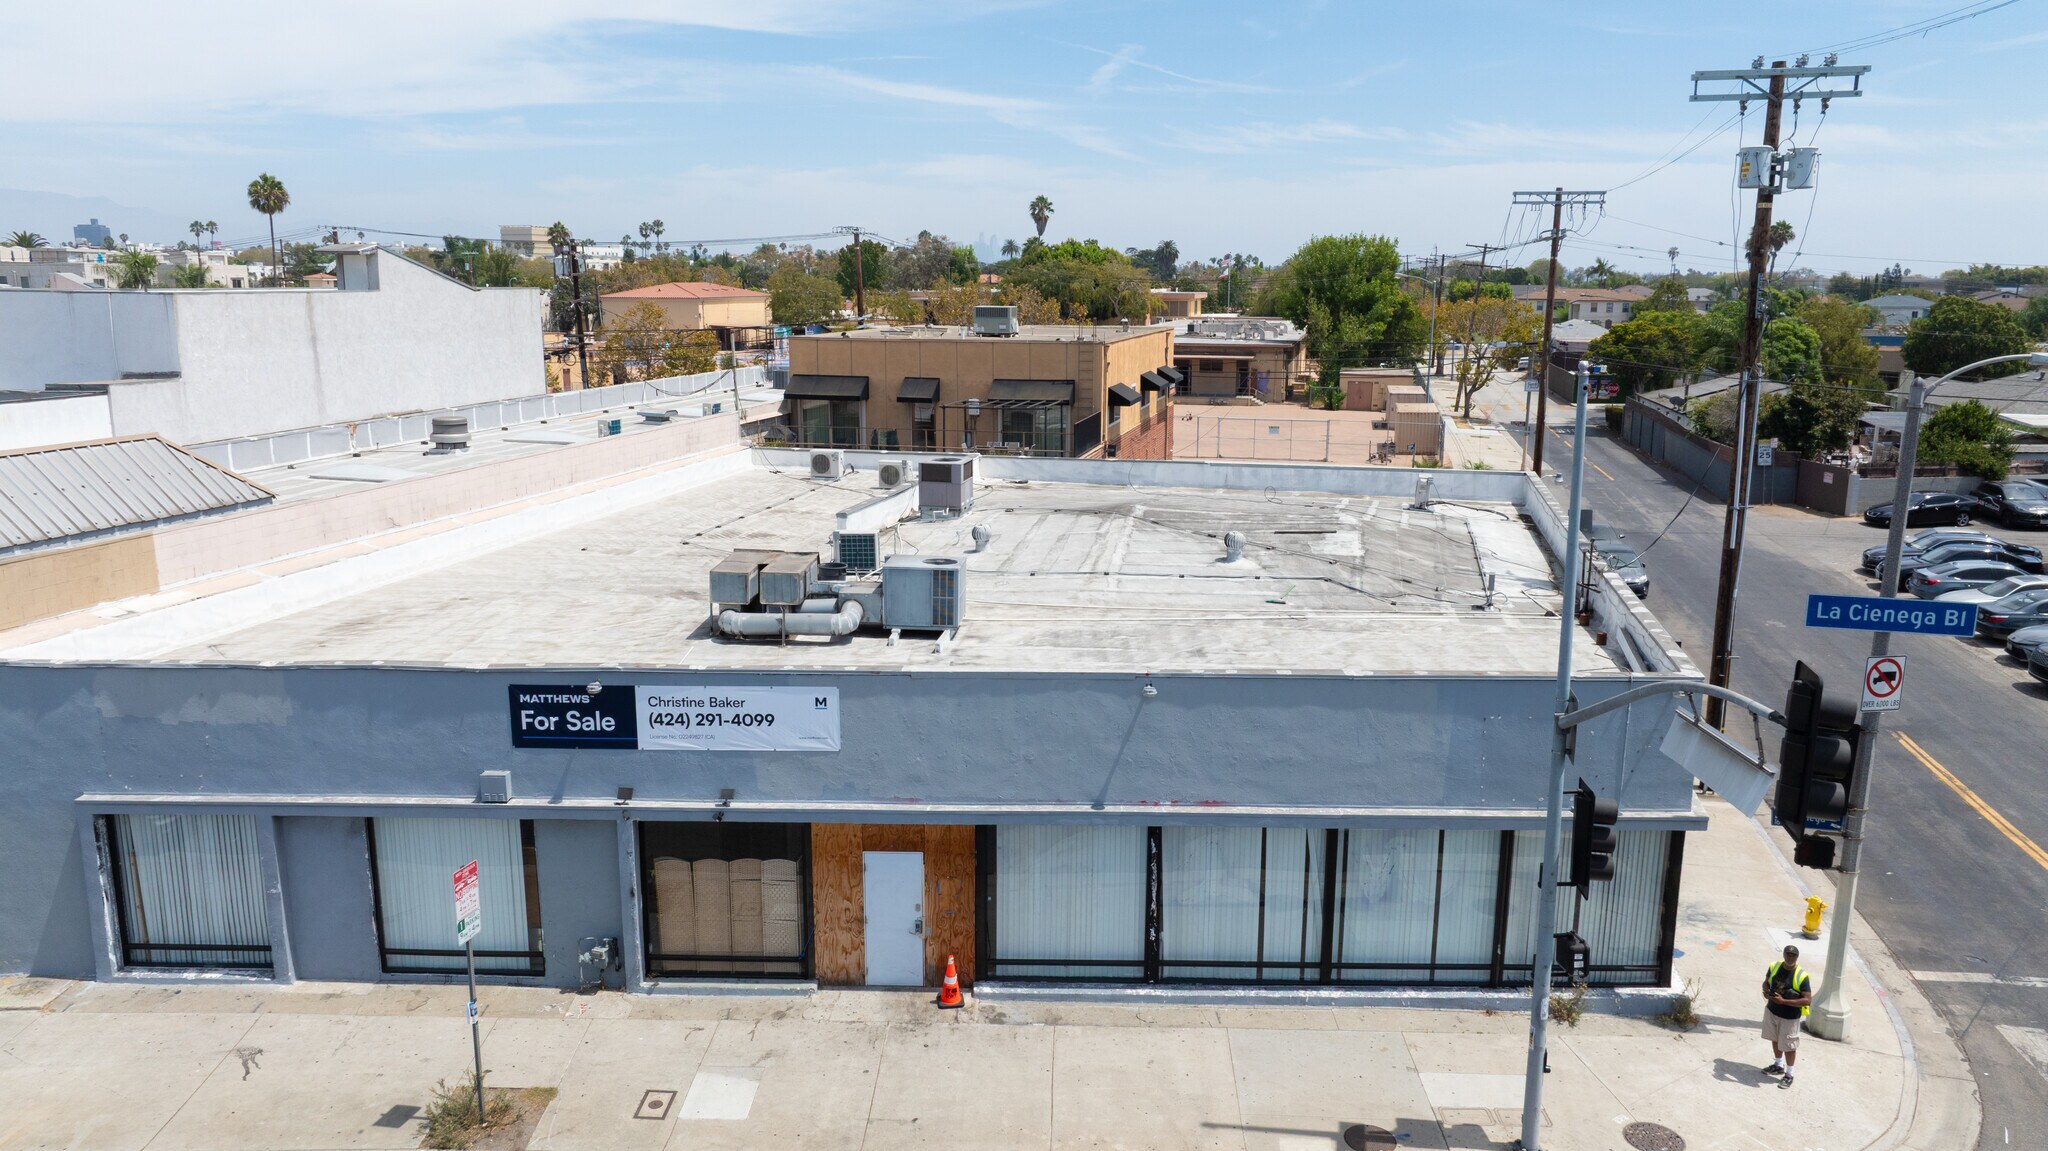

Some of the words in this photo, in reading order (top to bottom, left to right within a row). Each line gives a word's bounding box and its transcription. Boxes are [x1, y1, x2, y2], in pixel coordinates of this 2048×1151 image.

[1816, 602, 1841, 620] La
[1849, 604, 1936, 629] Cienega
[1944, 609, 1967, 627] Bl
[519, 694, 590, 704] MATTHEWS
[648, 696, 705, 708] Christine
[709, 696, 746, 708] Baker
[815, 697, 827, 707] M
[521, 710, 559, 731] For
[566, 710, 616, 731] Sale
[649, 712, 691, 730] (424)
[695, 713, 775, 727] 291-4099
